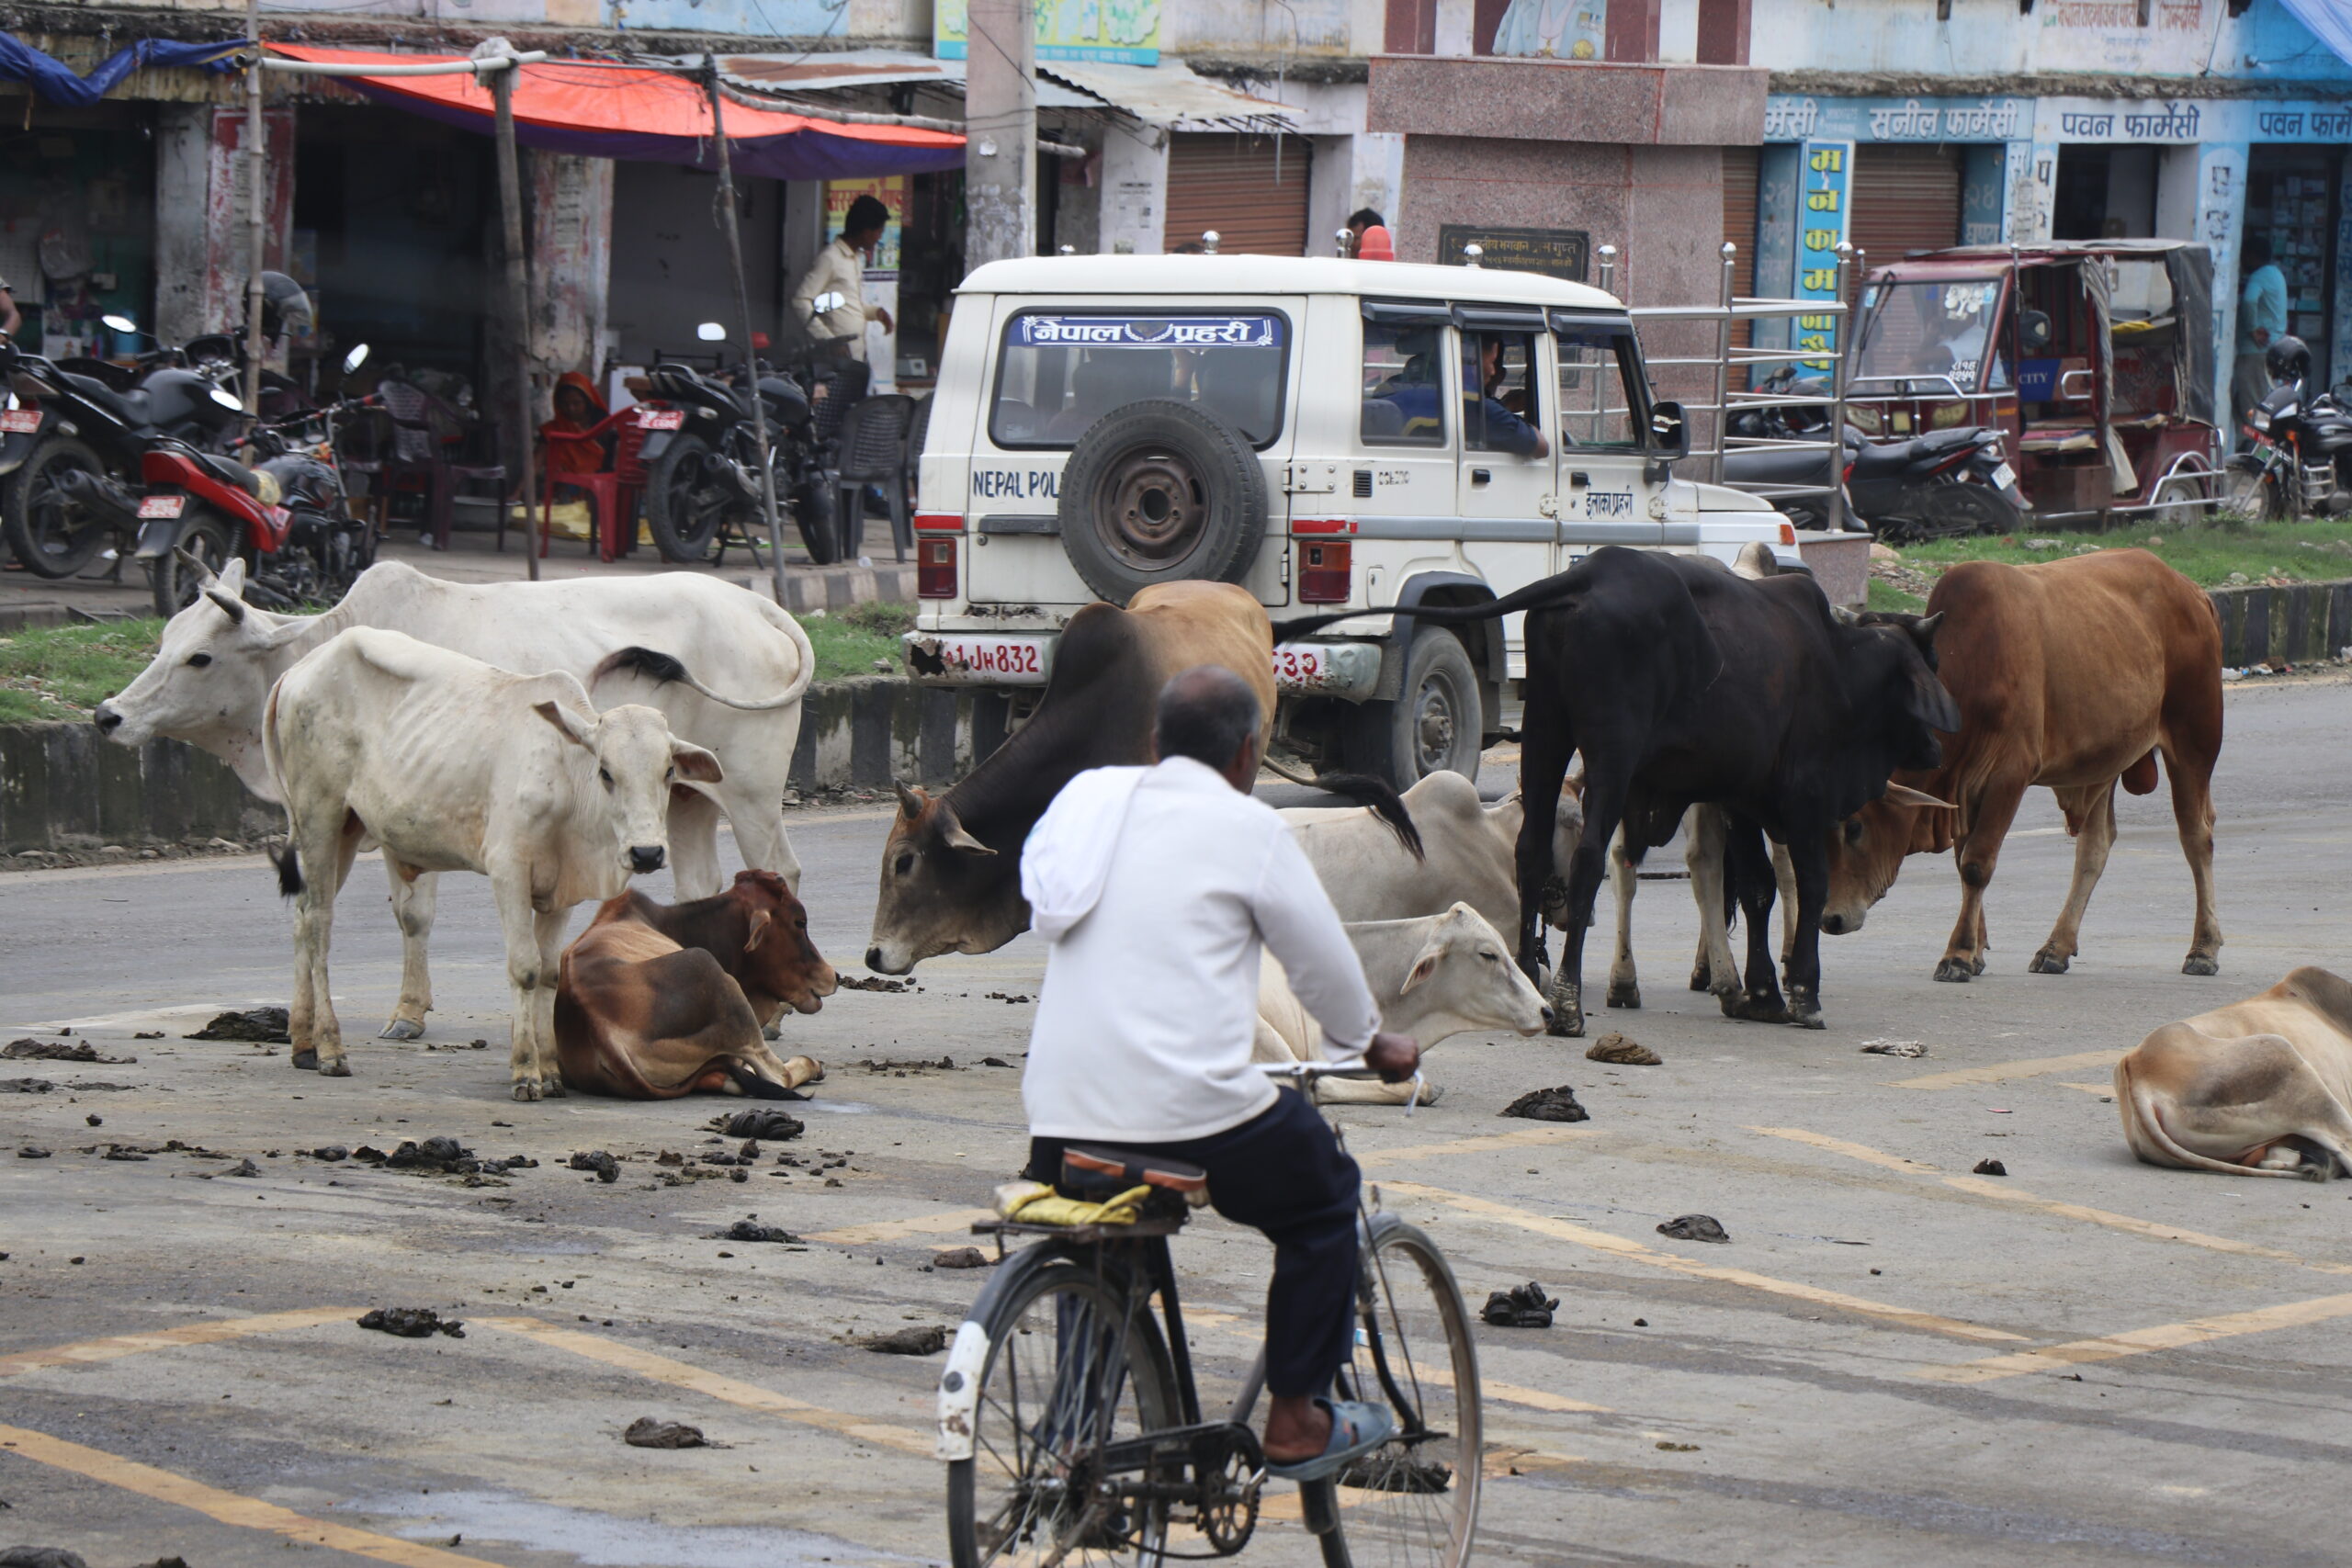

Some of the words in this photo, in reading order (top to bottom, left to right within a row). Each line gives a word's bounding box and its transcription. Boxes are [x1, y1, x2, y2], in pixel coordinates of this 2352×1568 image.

[1765, 98, 1818, 137] र्मेसी
[1869, 99, 1939, 140] सुनील
[1945, 98, 2018, 138] फार्मेसी
[2062, 111, 2114, 137] पवन
[2124, 102, 2200, 138] फार्मेसी
[2259, 111, 2303, 136] पवन
[2311, 106, 2352, 137] फार्मे
[1034, 321, 1125, 343] नेपाल
[1172, 321, 1251, 344] प्रहरी
[2018, 372, 2048, 385] CITY
[973, 470, 1024, 499] NEPAL
[1028, 470, 1064, 499] POL
